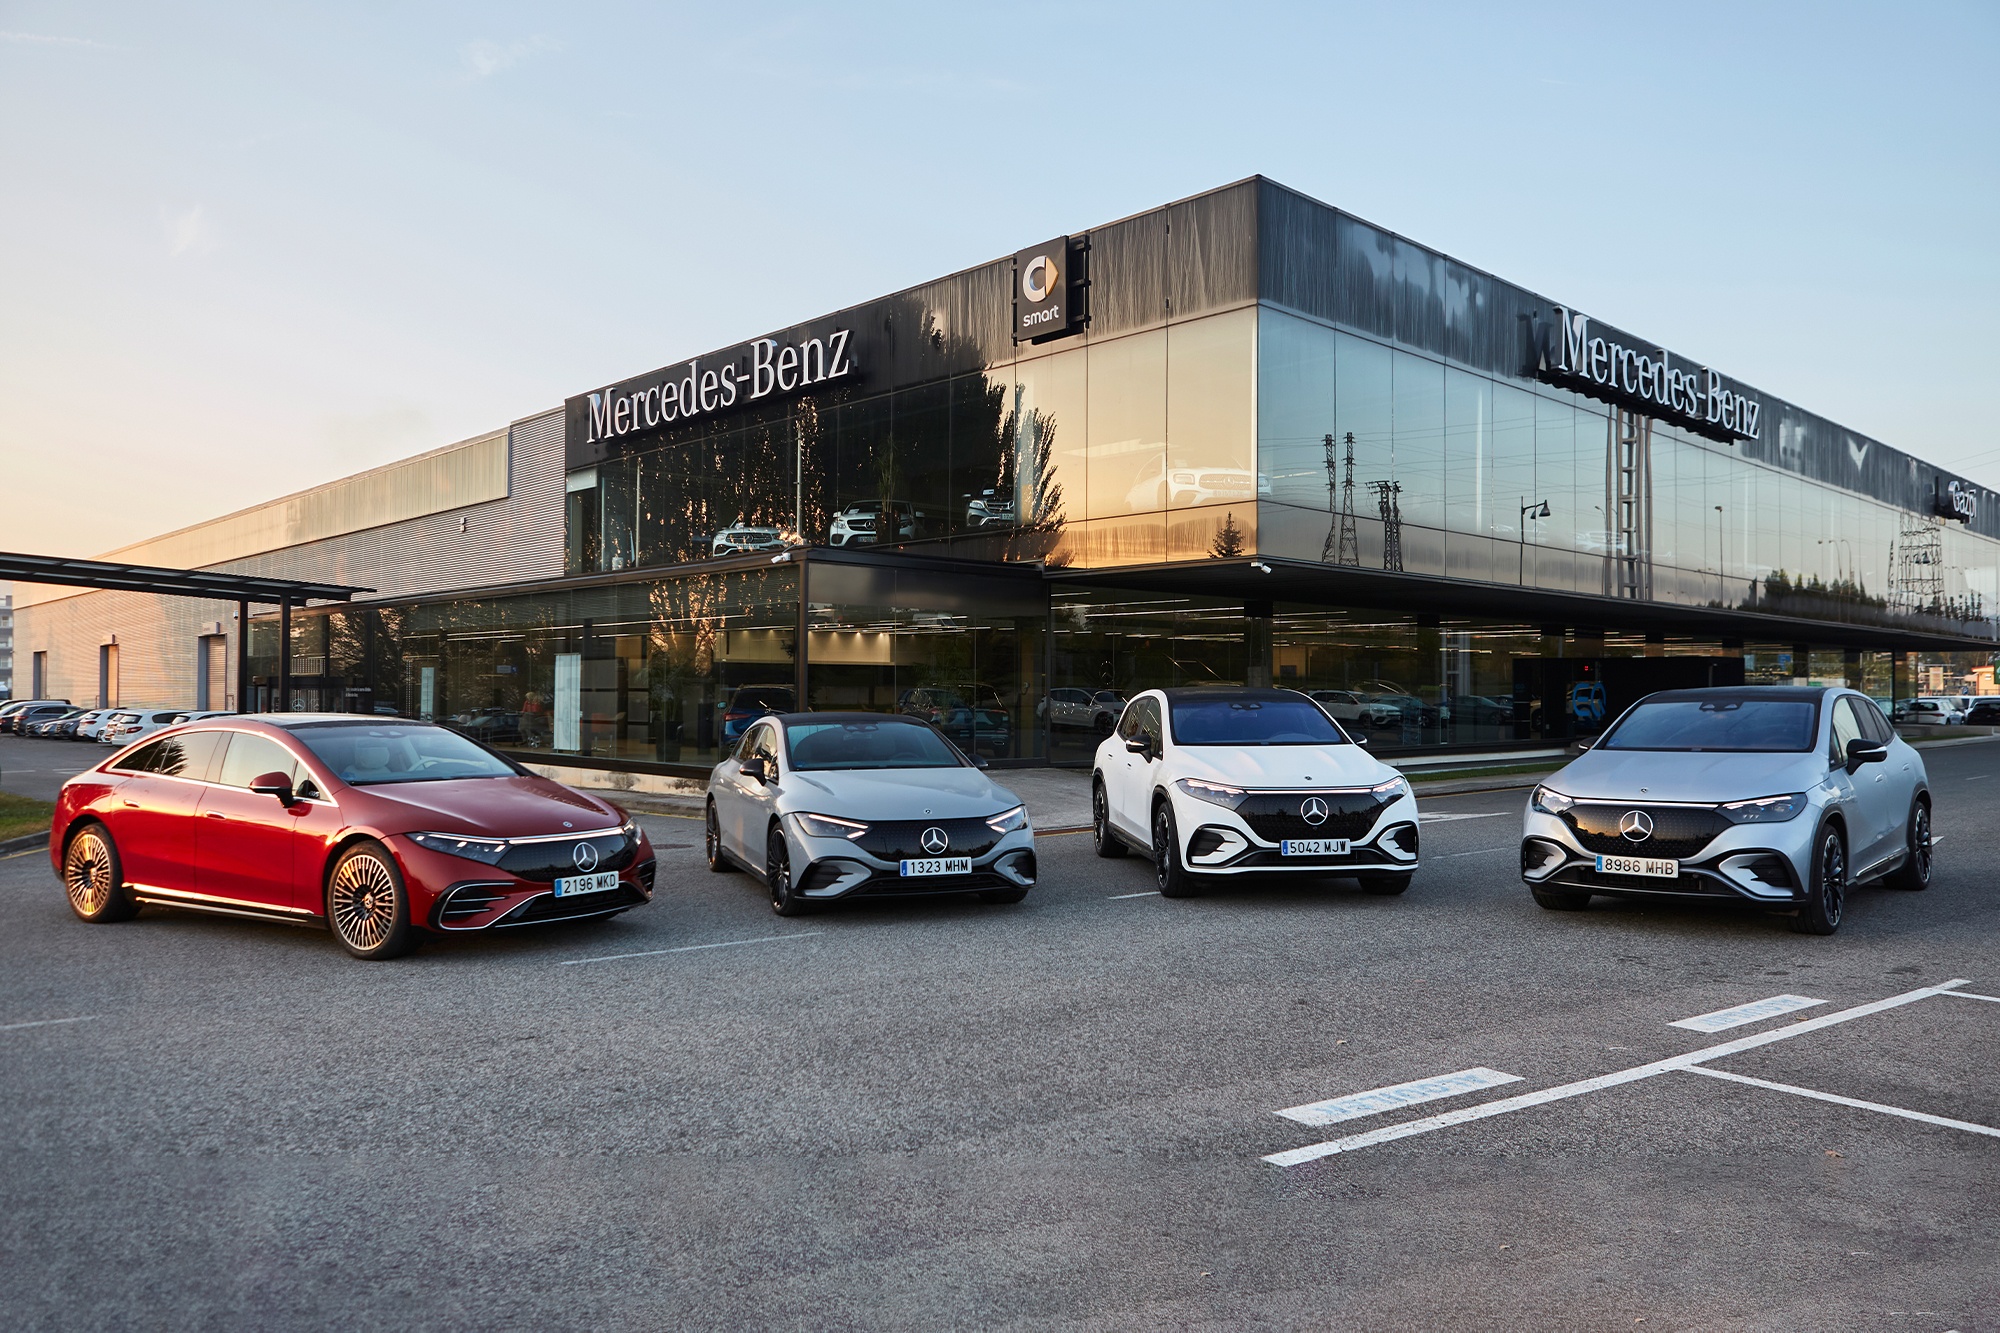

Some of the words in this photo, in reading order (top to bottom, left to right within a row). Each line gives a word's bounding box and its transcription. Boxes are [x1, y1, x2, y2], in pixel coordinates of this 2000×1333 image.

[1023, 305, 1059, 327] smart
[1554, 305, 1760, 440] Mercedes-Benz
[586, 329, 850, 444] Mercedes-Benz
[1290, 841, 1320, 854] 5042
[1324, 841, 1346, 853] MJW
[911, 860, 941, 874] 1323
[945, 859, 968, 873] MHM
[1605, 858, 1640, 873] 8986
[1646, 860, 1674, 875] MHB
[564, 877, 593, 894] 2196
[596, 874, 616, 889] MKD
